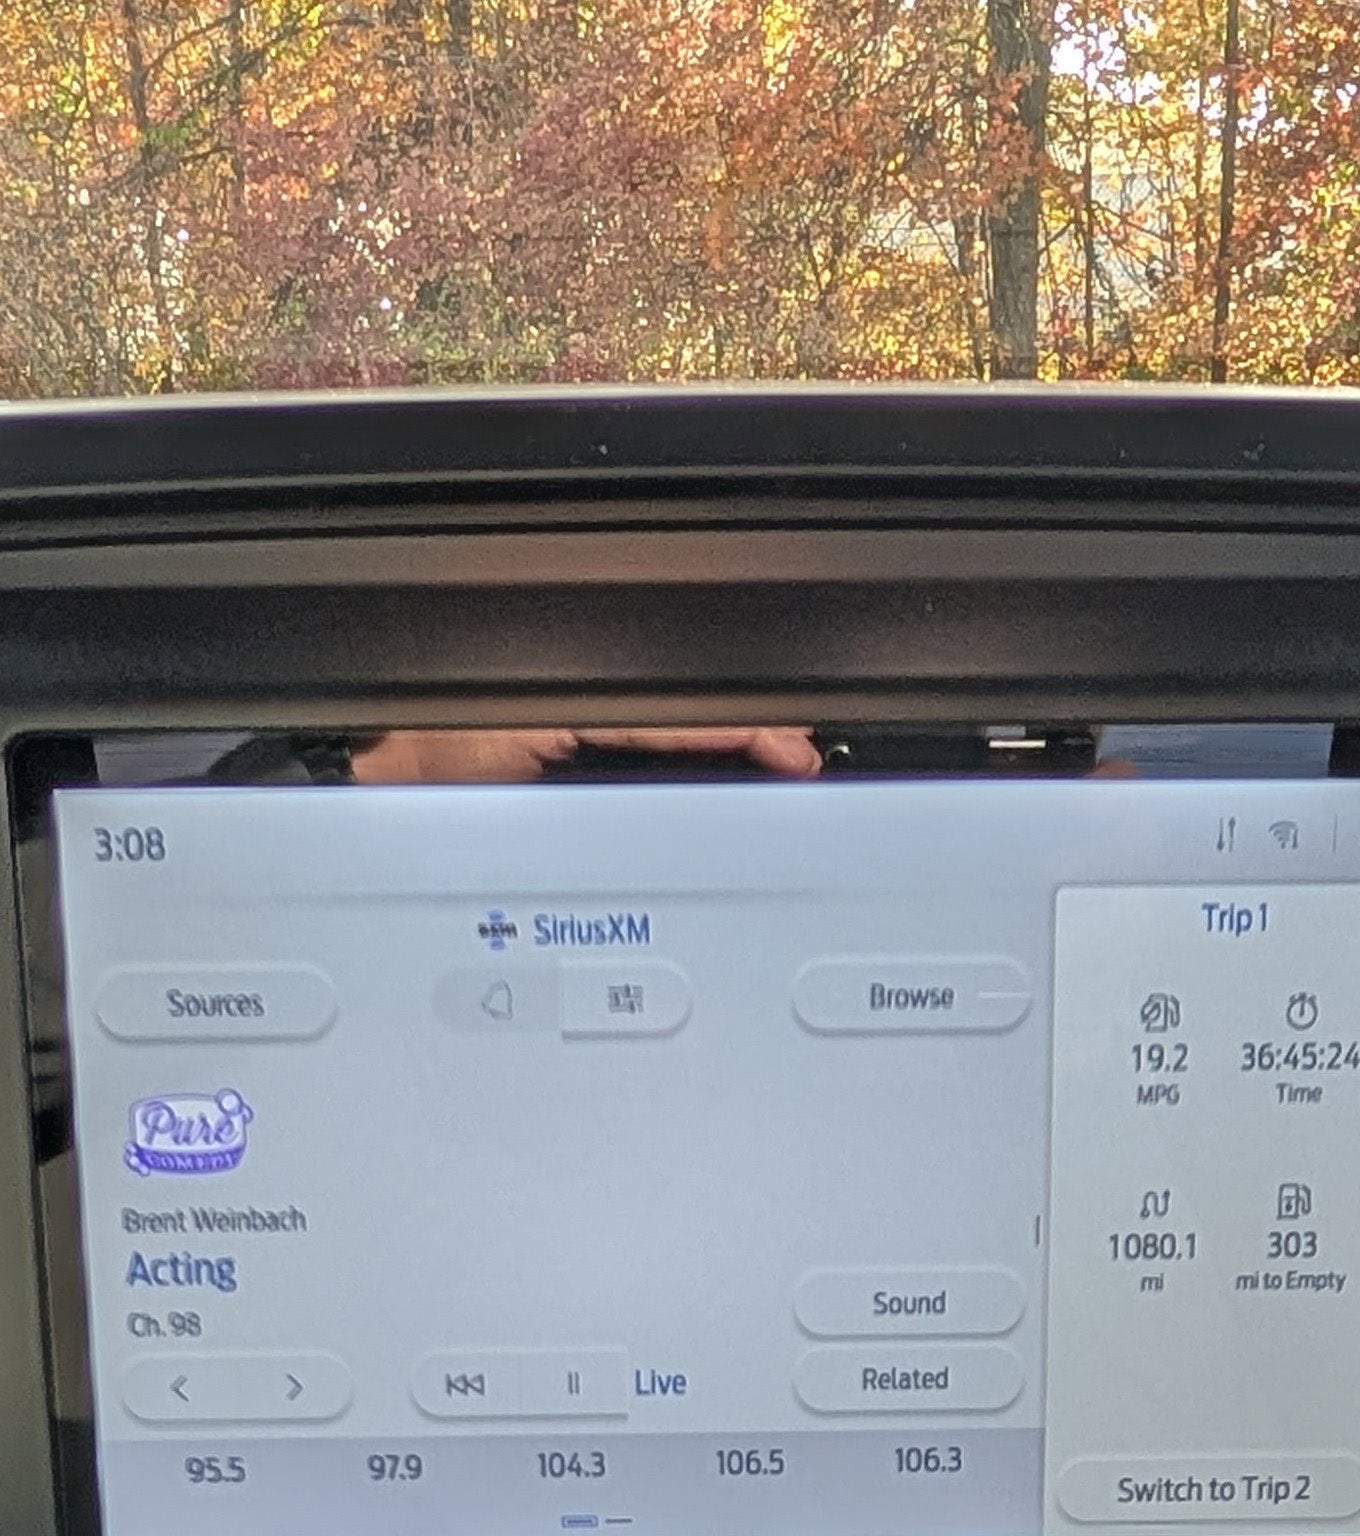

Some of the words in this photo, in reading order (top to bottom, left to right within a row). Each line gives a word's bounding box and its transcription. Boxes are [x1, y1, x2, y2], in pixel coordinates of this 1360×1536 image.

[93, 826, 167, 863] 3:08
[533, 912, 650, 946] SiriusXM
[1201, 903, 1252, 937] Trip
[1259, 903, 1270, 931] 1
[166, 987, 265, 1019] Sources
[869, 983, 955, 1010] Browse
[1130, 1044, 1189, 1073] 19.2
[1240, 1042, 1360, 1073] 36:45:24
[1137, 1083, 1180, 1105] MPG
[1276, 1082, 1323, 1105] Time
[142, 1100, 239, 1145] Pure
[121, 1207, 187, 1235] Brent
[190, 1205, 308, 1234] Weinbach
[1108, 1233, 1198, 1261] 1080.1
[1267, 1231, 1317, 1260] 303
[126, 1250, 238, 1293] Acting
[1141, 1271, 1165, 1291] mi
[1235, 1271, 1259, 1290] mi
[1262, 1272, 1282, 1290] to
[1285, 1270, 1347, 1293] Empty
[873, 1290, 947, 1315] Sound
[127, 1313, 168, 1338] Ch.
[170, 1312, 202, 1337] 98
[635, 1369, 687, 1397] Live
[862, 1367, 949, 1391] Related
[184, 1456, 246, 1484] 95.5
[367, 1453, 422, 1482] 97.9
[537, 1451, 606, 1479] 104.3
[715, 1449, 785, 1476] 106.5
[894, 1447, 963, 1473] 106.3
[1117, 1476, 1202, 1503] Switch
[1207, 1479, 1234, 1501] to
[1242, 1476, 1289, 1506] Trip
[1294, 1477, 1311, 1500] 2
